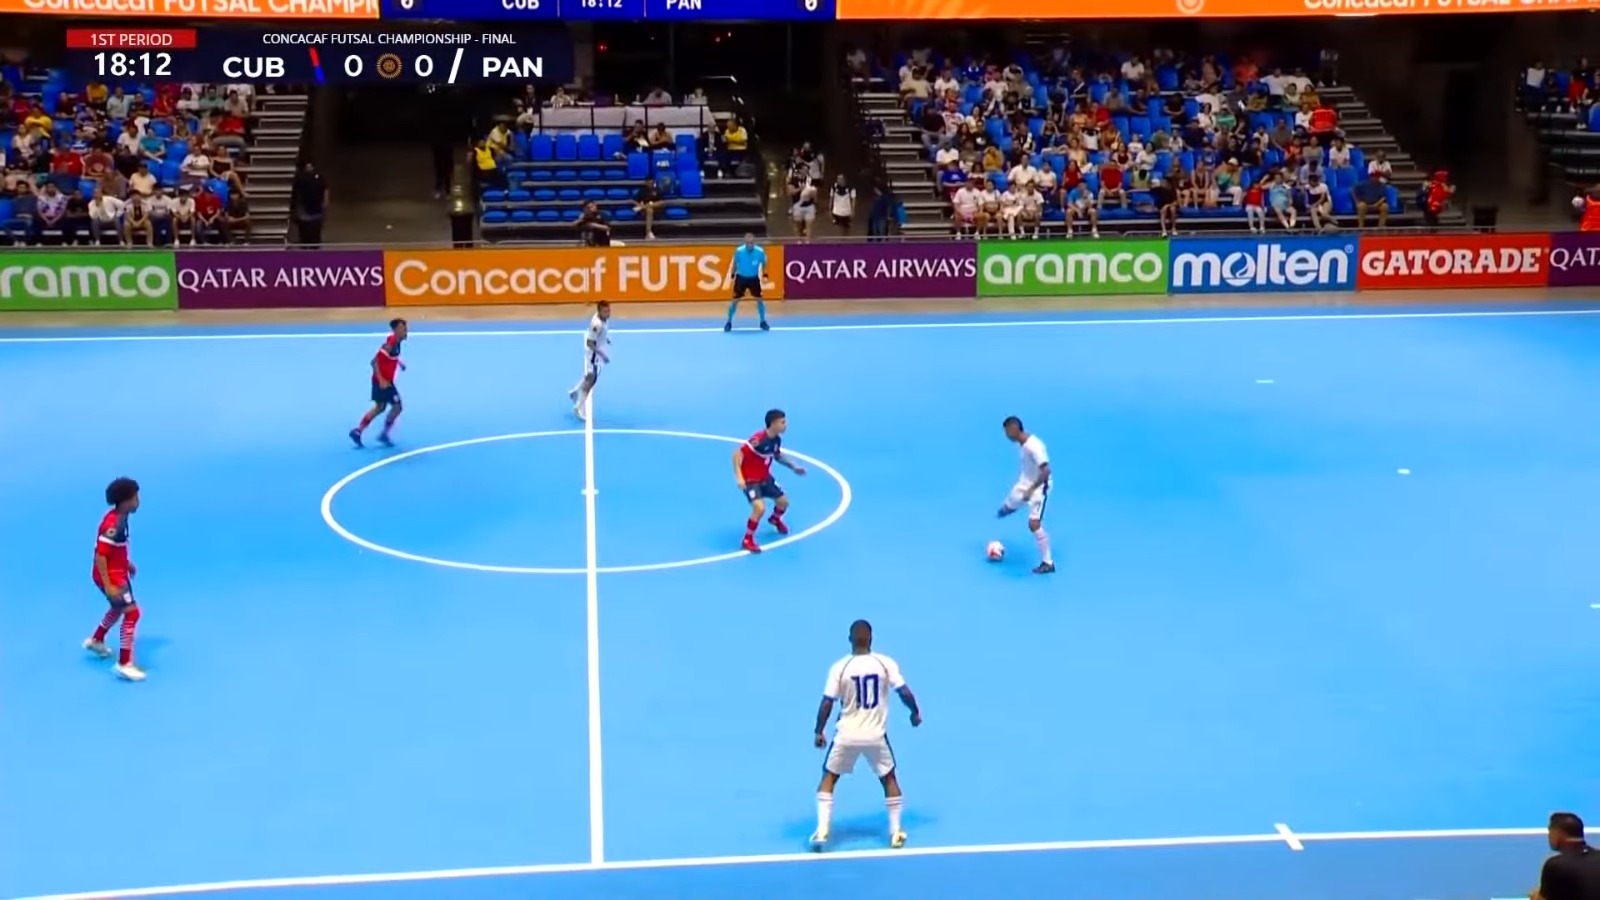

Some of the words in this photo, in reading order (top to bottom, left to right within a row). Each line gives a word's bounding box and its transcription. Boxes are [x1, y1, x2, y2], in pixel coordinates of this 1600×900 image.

[268, 0, 379, 14] CHAMPI
[501, 0, 540, 10] CUB
[666, 0, 702, 10] PAN
[785, 259, 868, 284] QATAR
[874, 257, 977, 279] AIRWAYS
[983, 252, 1163, 284] aramco
[1172, 244, 1349, 287] molten
[1361, 247, 1542, 276] GATORADE
[1549, 247, 1600, 271] QAT
[177, 268, 267, 293] QATAR
[274, 266, 384, 288] AIRWAYS
[394, 257, 606, 296] Concacaf
[850, 673, 880, 710] 10
